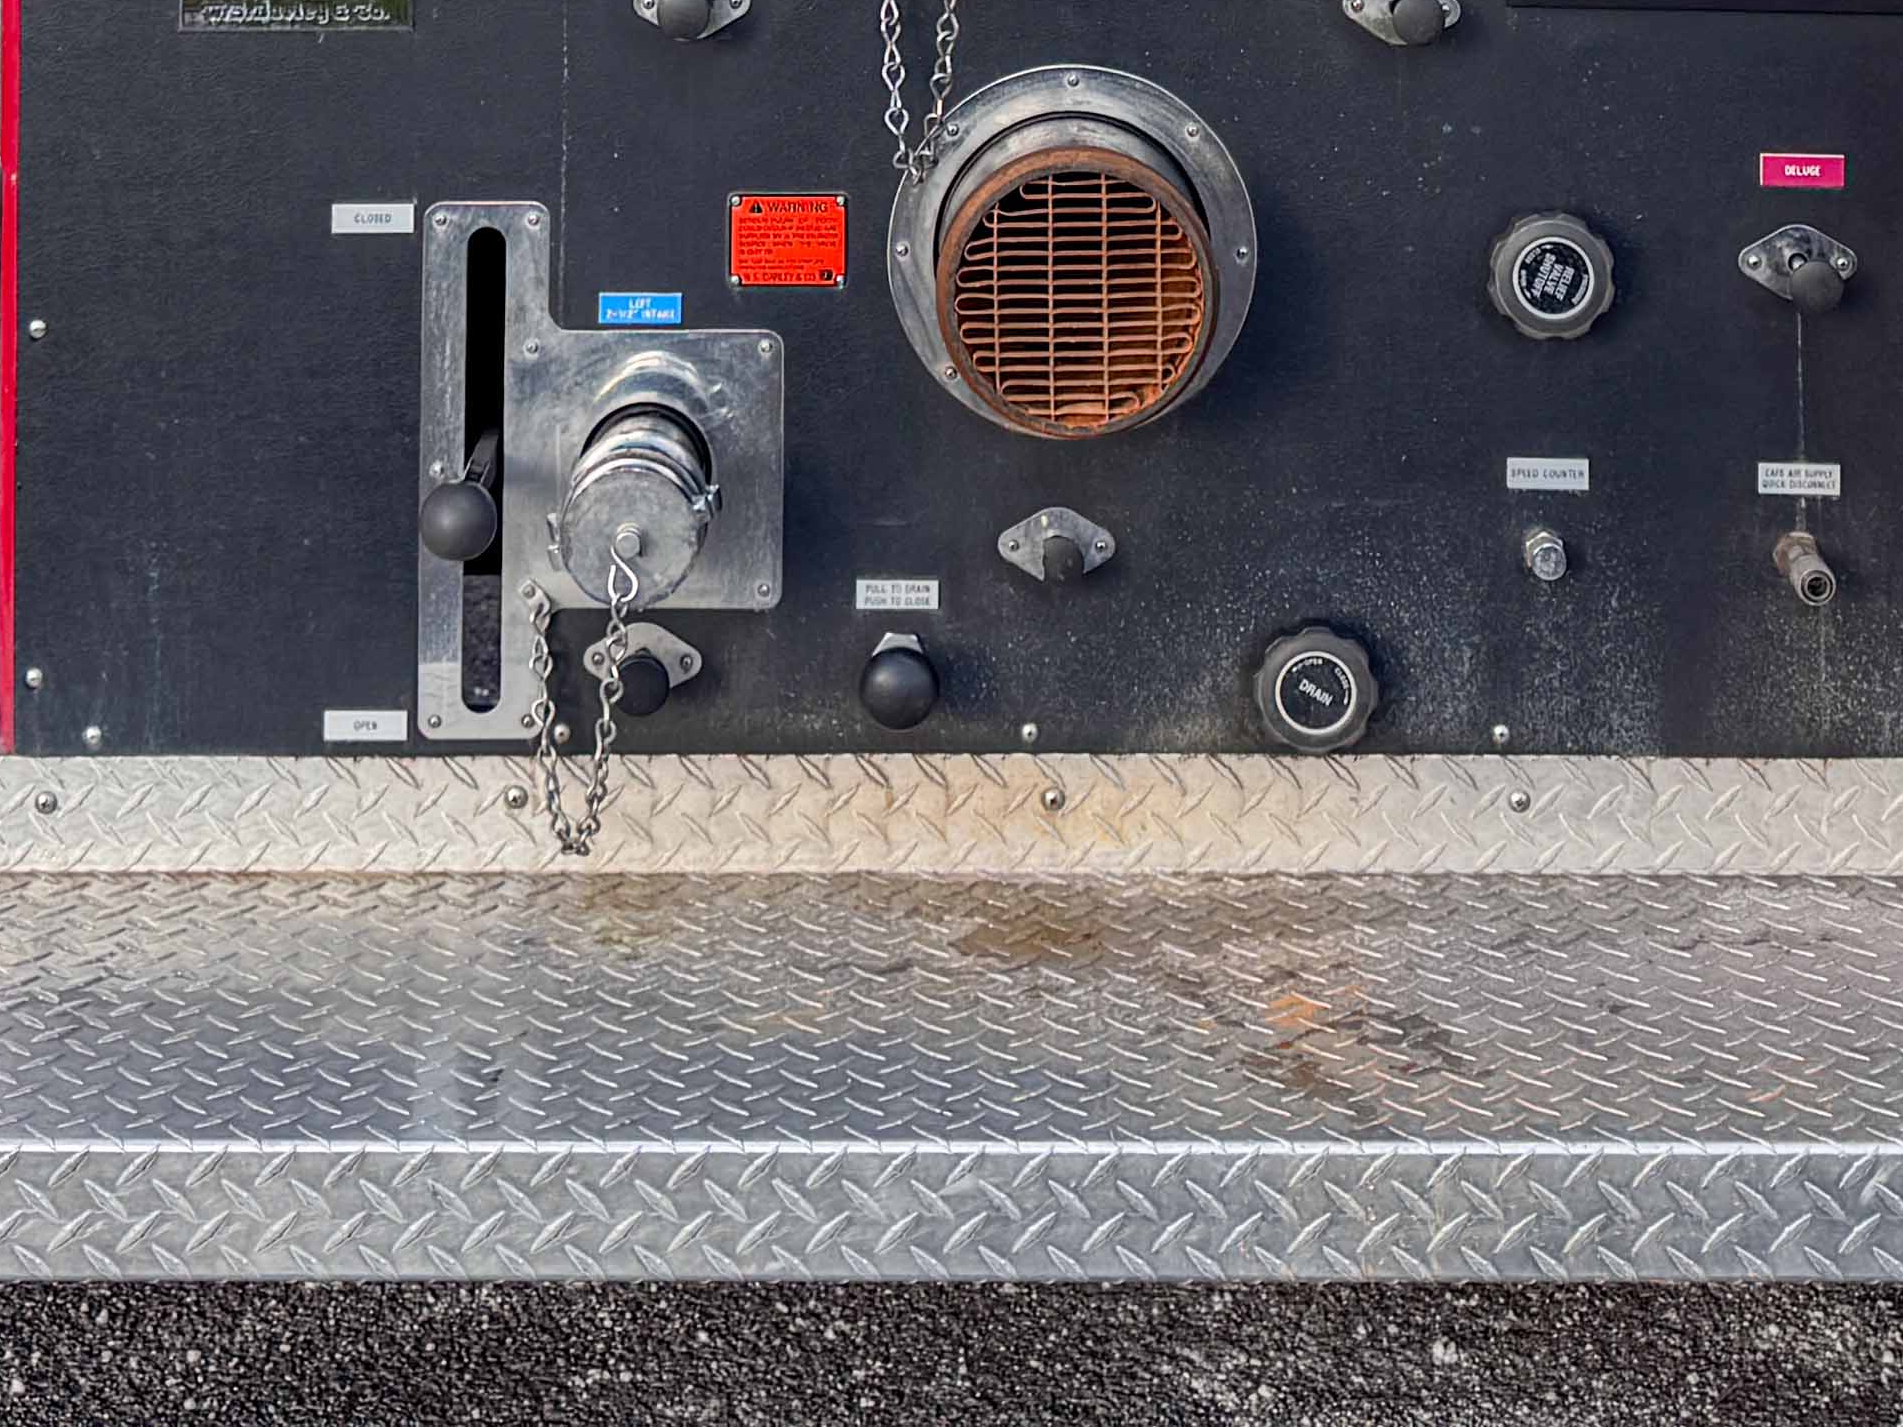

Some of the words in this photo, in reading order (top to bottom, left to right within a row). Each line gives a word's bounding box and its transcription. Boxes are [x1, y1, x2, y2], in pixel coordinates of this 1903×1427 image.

[1783, 164, 1821, 177] DELUGE
[768, 201, 828, 214] WARNING
[353, 213, 392, 224] CLOSED
[1530, 252, 1557, 298] SHUTOFF
[1543, 263, 1565, 295] VALVE
[1555, 266, 1575, 302] RELIEF
[628, 296, 652, 309] LEFT
[641, 309, 675, 319] INTAKE
[1510, 468, 1539, 479] SPEED
[1543, 468, 1585, 480] COUNTER
[1789, 479, 1836, 490] DISCONNECT
[865, 584, 886, 594] PULL
[891, 584, 903, 594] TO
[905, 584, 931, 594] DRAIN
[865, 596, 887, 606] PUSH
[891, 596, 902, 606] TO
[905, 596, 930, 606] CLOSE
[1299, 678, 1334, 707] DRAIN
[352, 719, 378, 732] OPEN
